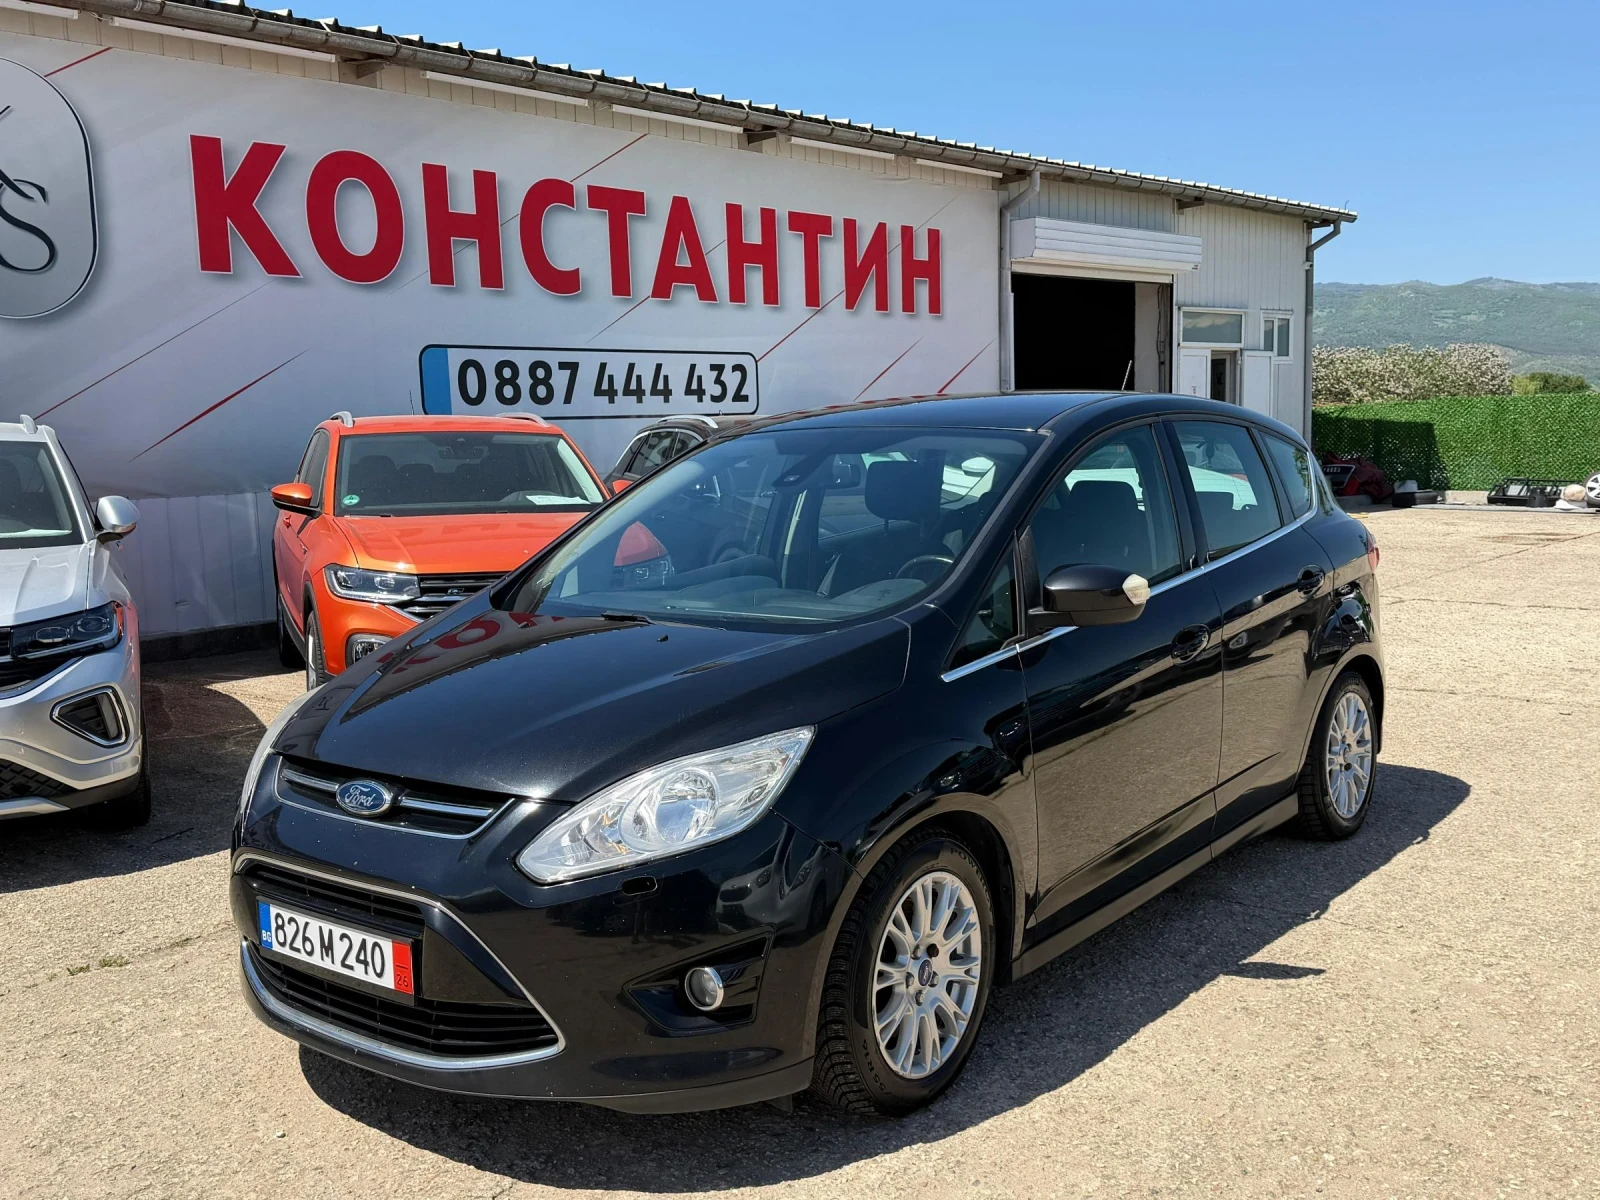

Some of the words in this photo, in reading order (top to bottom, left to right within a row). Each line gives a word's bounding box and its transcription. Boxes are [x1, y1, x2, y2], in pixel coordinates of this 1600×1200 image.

[189, 134, 942, 315] КОНСТАНТИН
[457, 359, 580, 406] 0887
[593, 362, 673, 404] 444
[684, 363, 749, 403] 432
[344, 784, 377, 809] Ford
[261, 930, 272, 943] BG
[274, 912, 315, 957] 826
[339, 932, 386, 979] 240
[396, 973, 409, 988] 26
